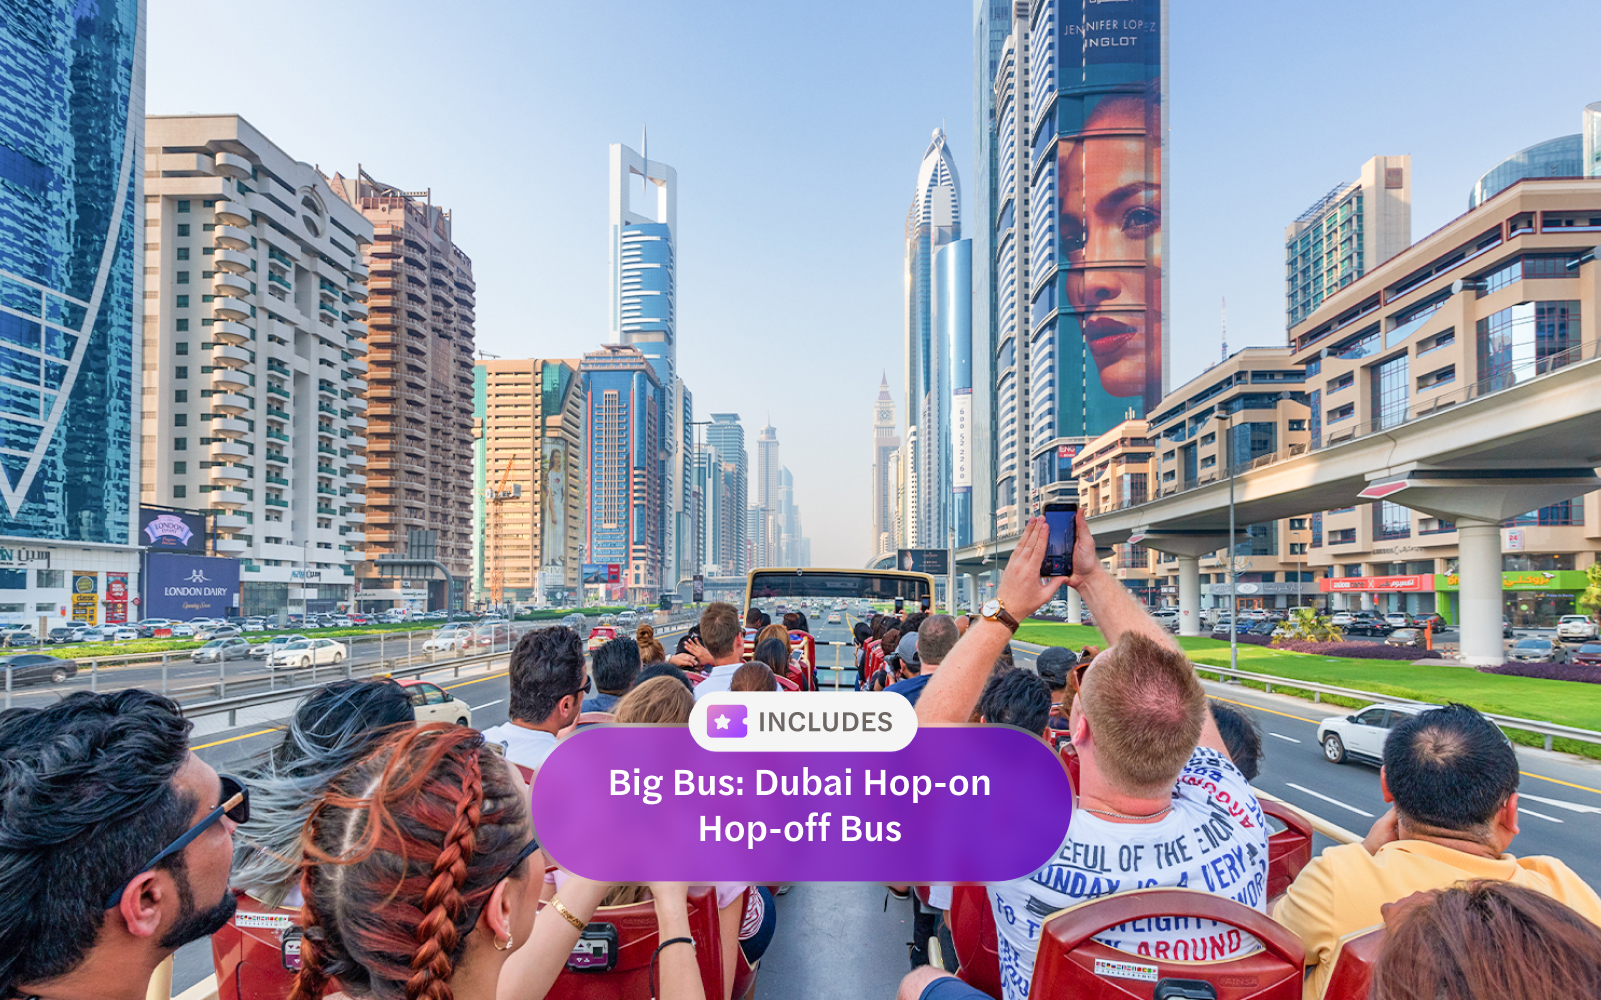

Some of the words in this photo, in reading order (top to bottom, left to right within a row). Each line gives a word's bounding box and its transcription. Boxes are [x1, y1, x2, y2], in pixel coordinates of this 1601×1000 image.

[1064, 20, 1118, 36] JENNIFER
[1123, 19, 1156, 32] LOPEZ
[1084, 36, 1138, 48] INGLOT
[164, 586, 202, 597] LONDON
[203, 586, 228, 597] DAIRY
[1059, 838, 1112, 872] EFUL
[1119, 845, 1145, 872] OF
[1154, 834, 1193, 870] THE
[1030, 865, 1121, 900] ONDAY
[1201, 845, 1247, 893] VERY
[1137, 929, 1242, 961] AROUND
